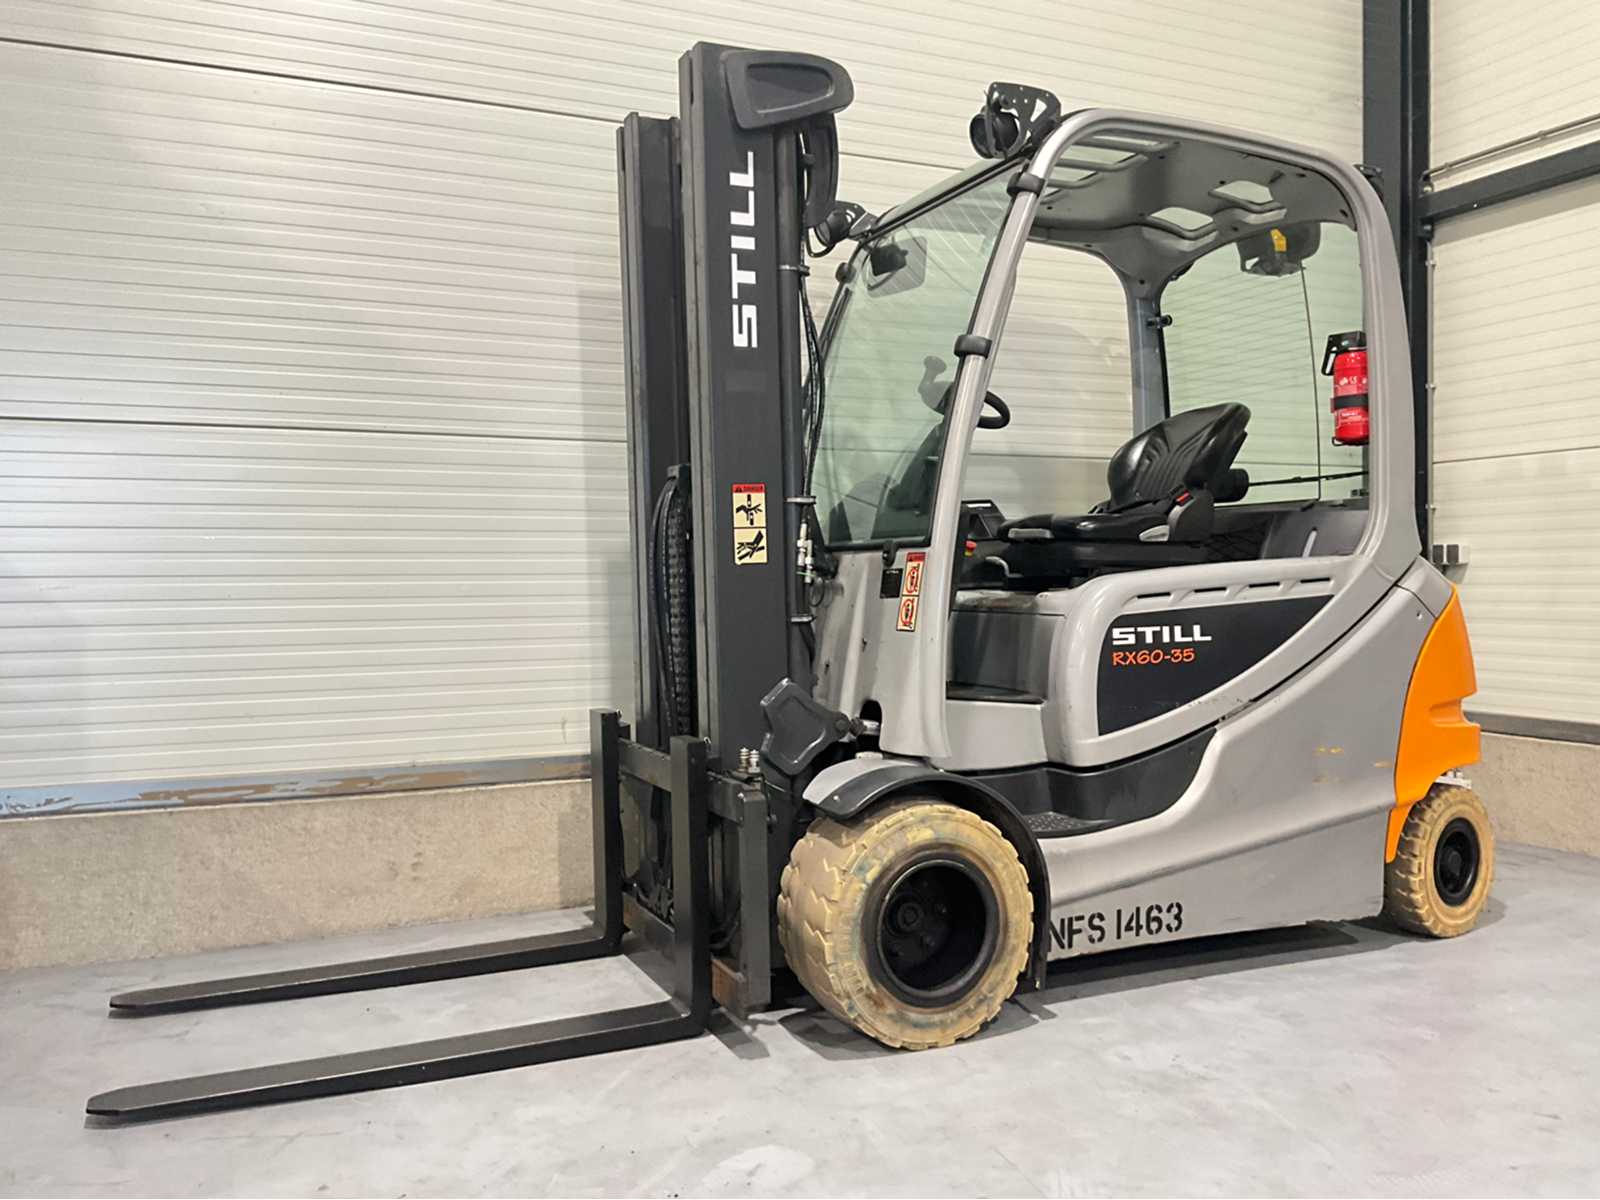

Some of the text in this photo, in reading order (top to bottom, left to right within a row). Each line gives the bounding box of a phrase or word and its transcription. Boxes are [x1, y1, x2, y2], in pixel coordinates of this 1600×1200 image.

[730, 151, 758, 349] STILL
[1112, 625, 1212, 645] STILL
[1112, 648, 1195, 666] RX60-35
[1049, 902, 1184, 951] NFS 1463
